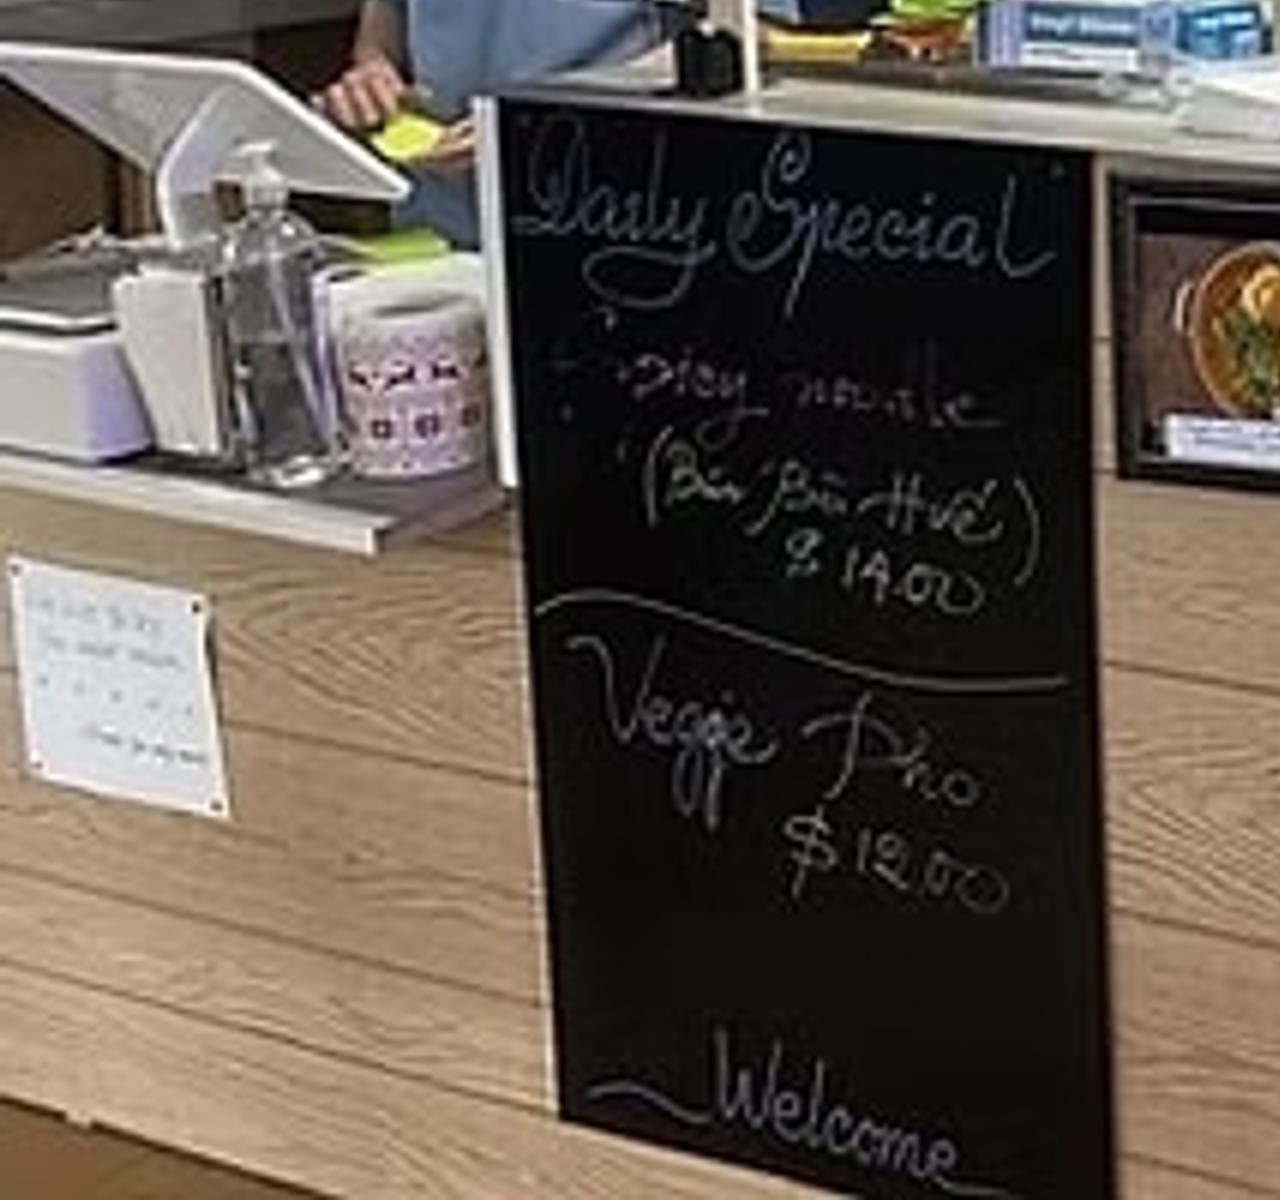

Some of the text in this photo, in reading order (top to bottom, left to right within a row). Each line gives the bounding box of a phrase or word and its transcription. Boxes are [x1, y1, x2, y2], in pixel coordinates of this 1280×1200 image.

[510, 114, 1057, 318] Daily Special
[565, 632, 779, 834] Veggie
[783, 805, 840, 902] $
[710, 1024, 980, 1188] Welcome
